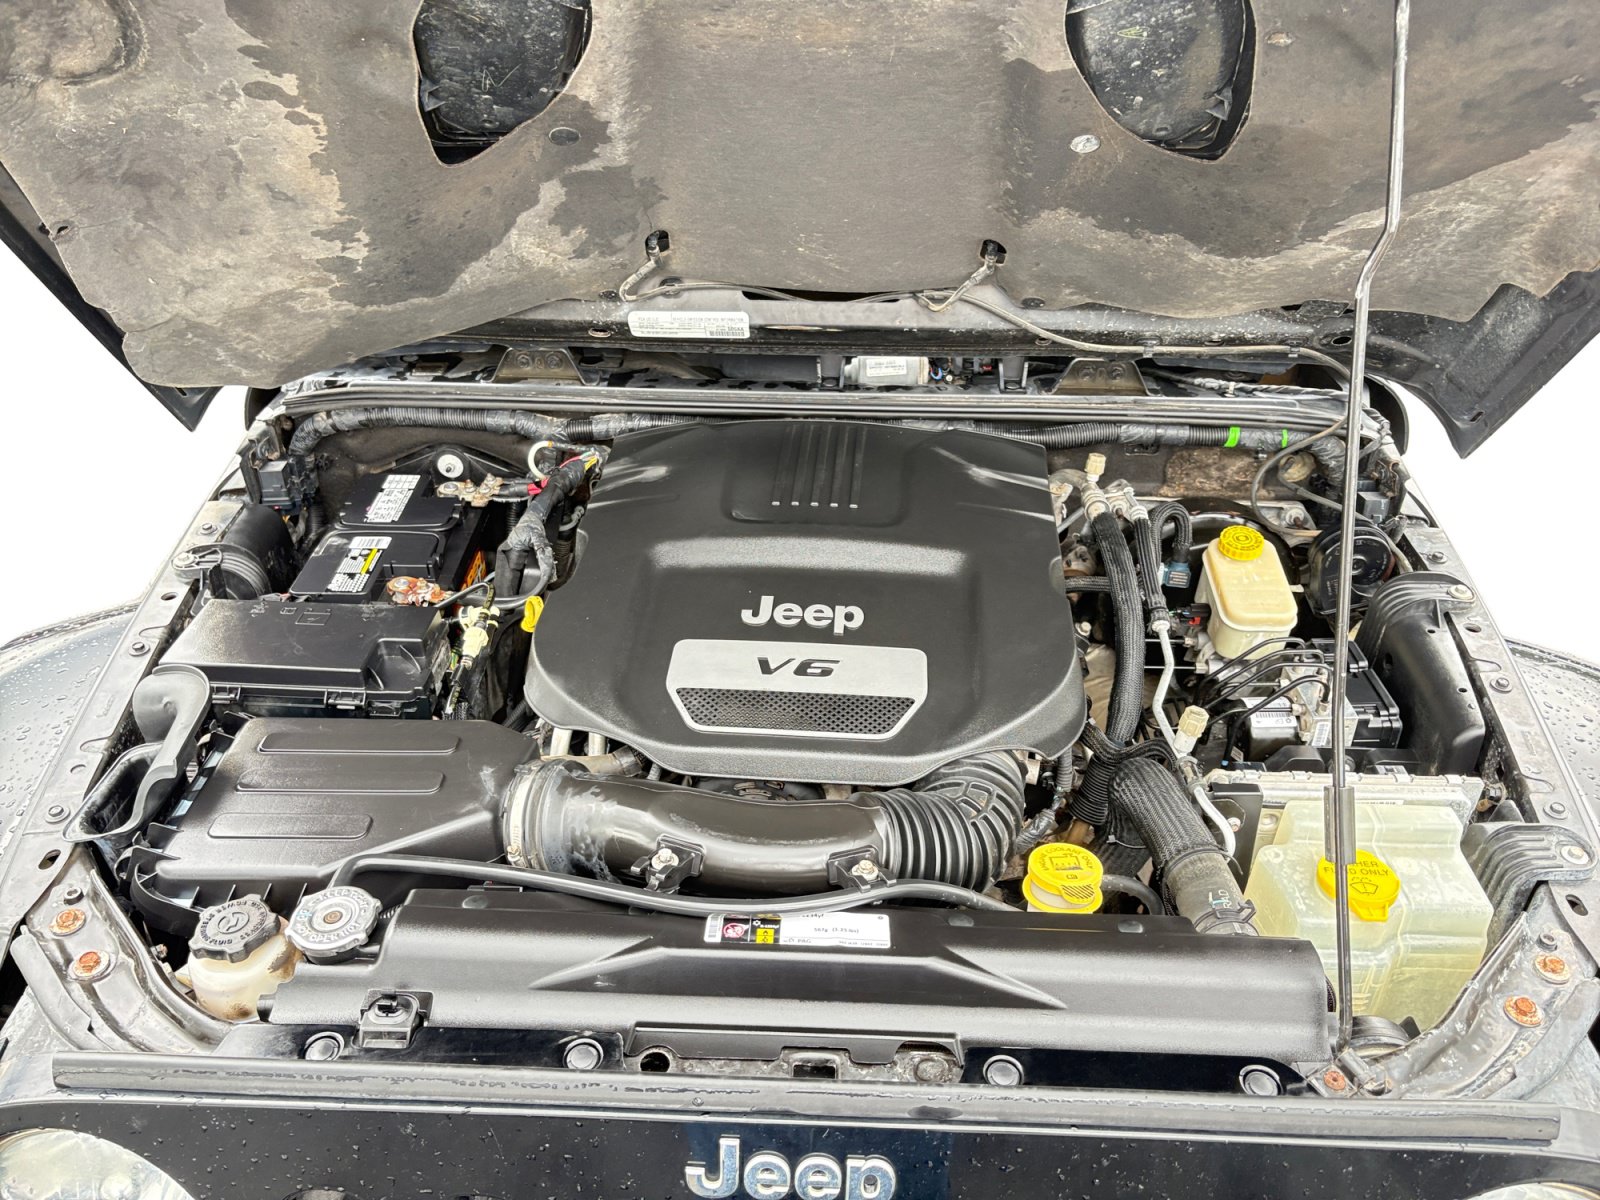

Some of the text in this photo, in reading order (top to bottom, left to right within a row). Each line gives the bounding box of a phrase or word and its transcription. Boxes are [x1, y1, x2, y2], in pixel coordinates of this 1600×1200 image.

[740, 595, 865, 636] Jeep
[757, 656, 841, 677] V6
[1045, 846, 1081, 860] COOLANT
[1323, 866, 1389, 876] FLD ONLY
[684, 1134, 897, 1200] Jeep
